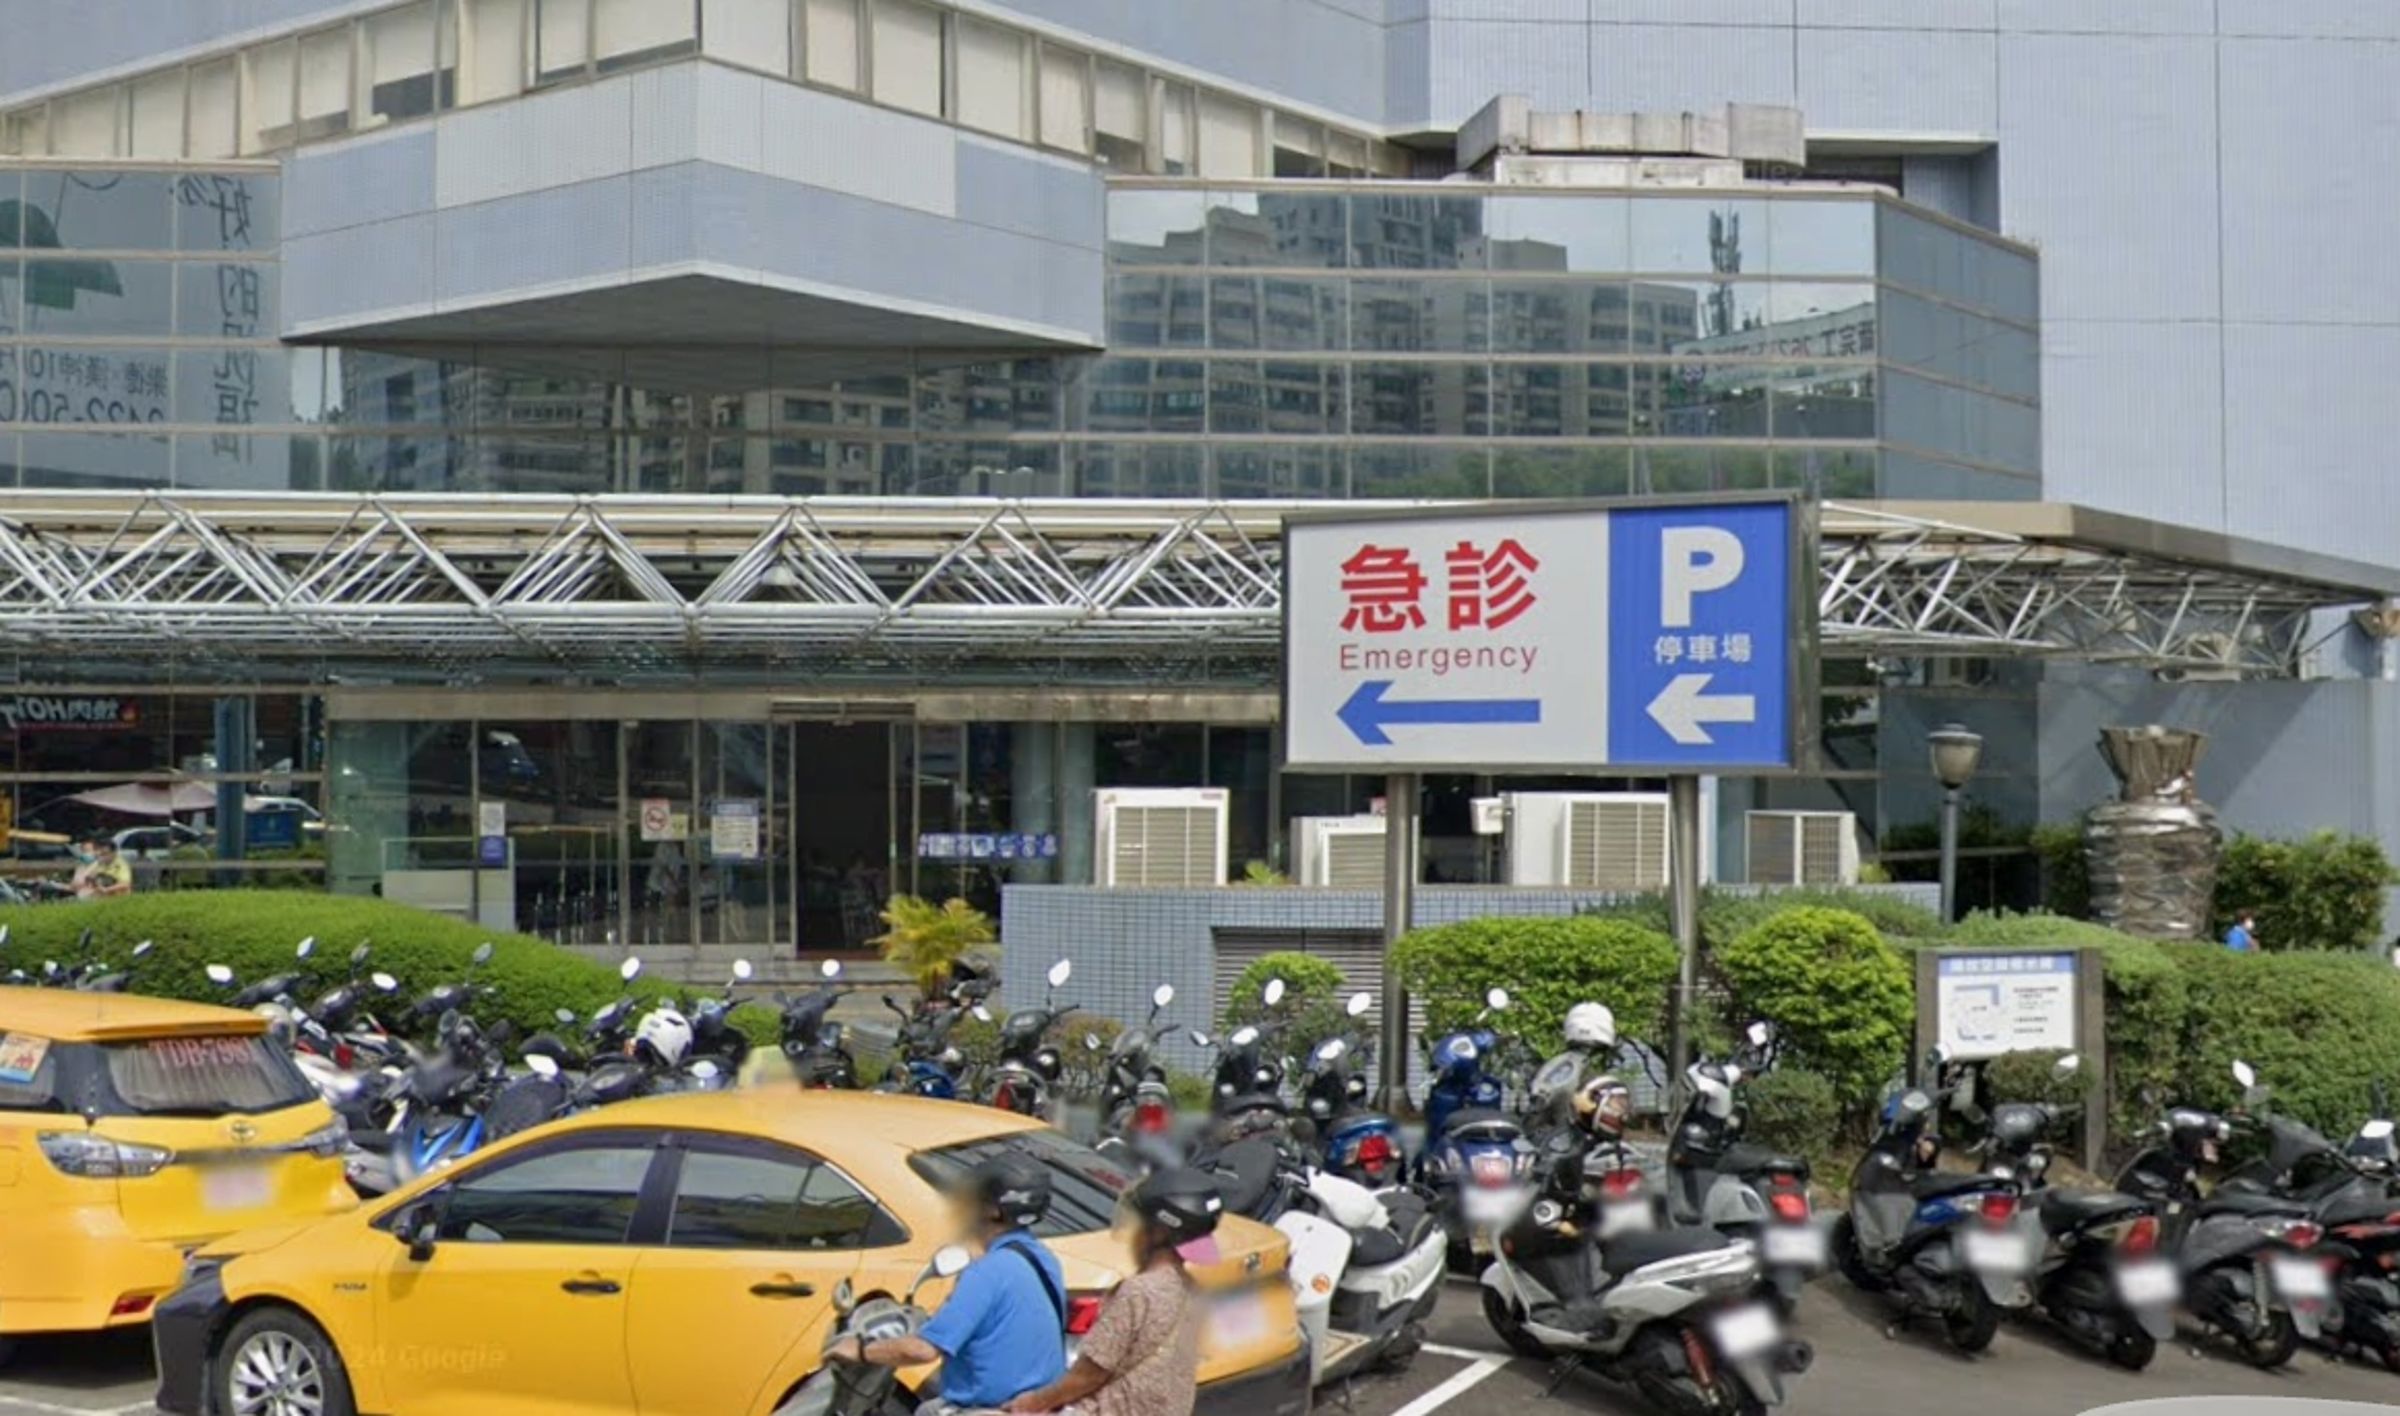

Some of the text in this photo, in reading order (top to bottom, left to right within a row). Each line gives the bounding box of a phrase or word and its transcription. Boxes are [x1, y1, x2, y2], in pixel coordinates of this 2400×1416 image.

[1340, 539, 1539, 633] 急診
[1661, 526, 1744, 627] P
[1340, 644, 1537, 675] Emergency
[1654, 633, 1752, 664] 停車場
